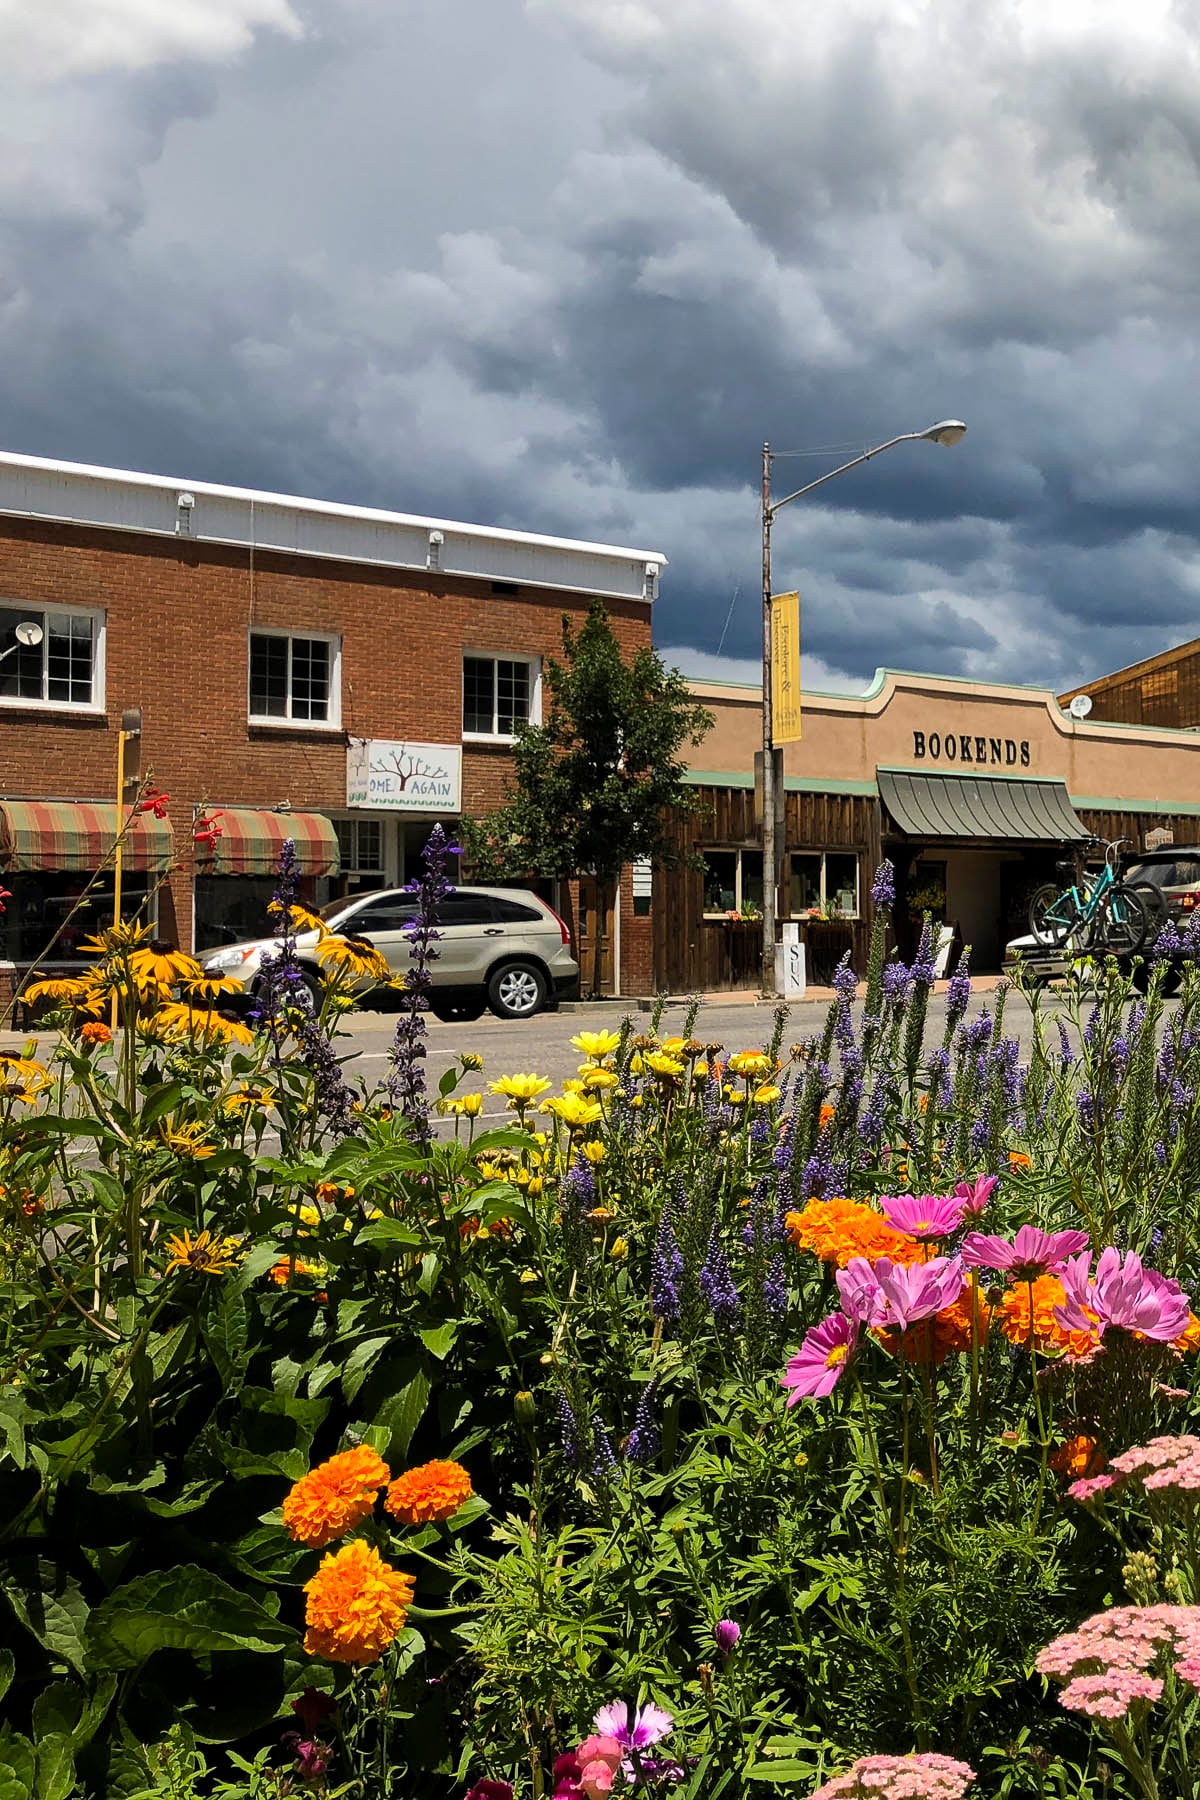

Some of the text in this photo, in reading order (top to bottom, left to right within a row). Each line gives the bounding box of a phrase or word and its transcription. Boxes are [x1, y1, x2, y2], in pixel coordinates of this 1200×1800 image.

[913, 731, 1030, 768] BOOKENDS
[369, 778, 452, 796] OME AGAIN
[790, 944, 800, 989] SUN
